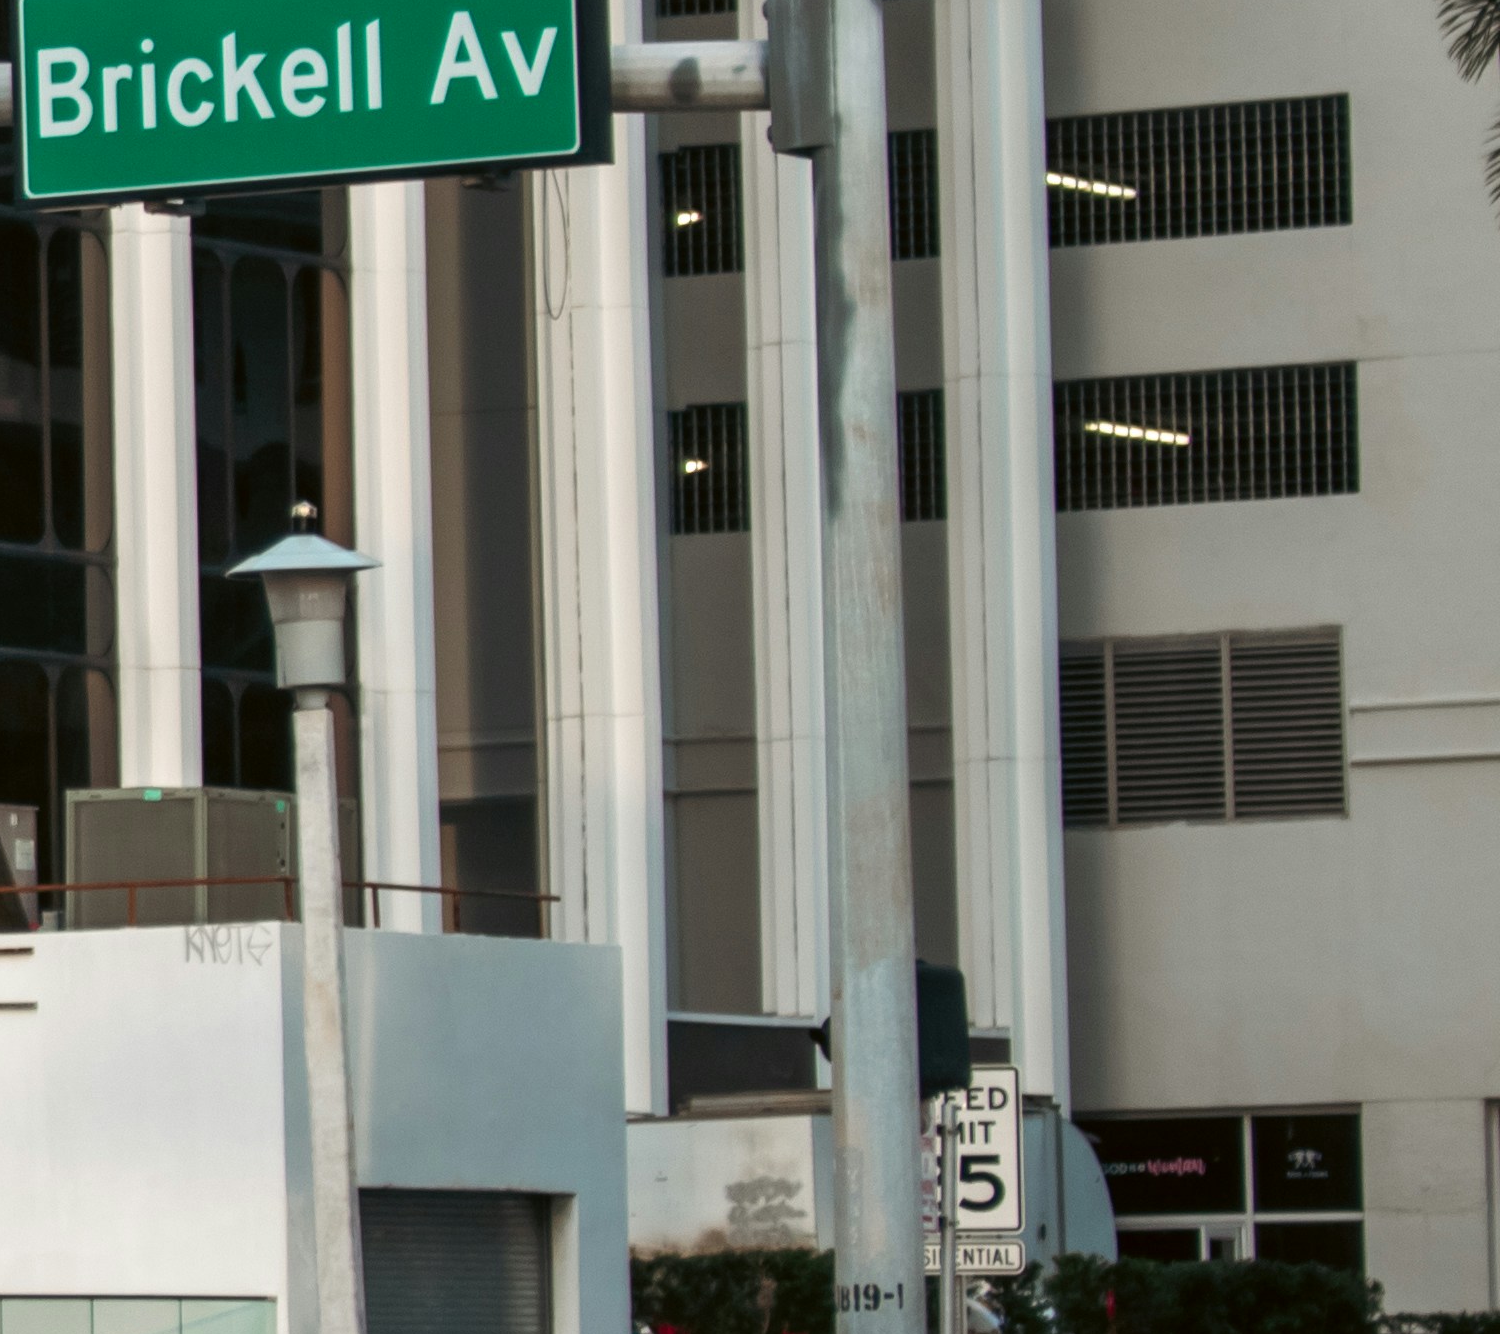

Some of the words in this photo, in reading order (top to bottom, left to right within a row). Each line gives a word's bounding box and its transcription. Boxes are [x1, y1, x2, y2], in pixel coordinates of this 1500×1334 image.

[37, 18, 382, 138] Brickell
[429, 11, 558, 105] Av
[943, 1088, 1009, 1111] EED
[957, 1154, 1006, 1212] 5
